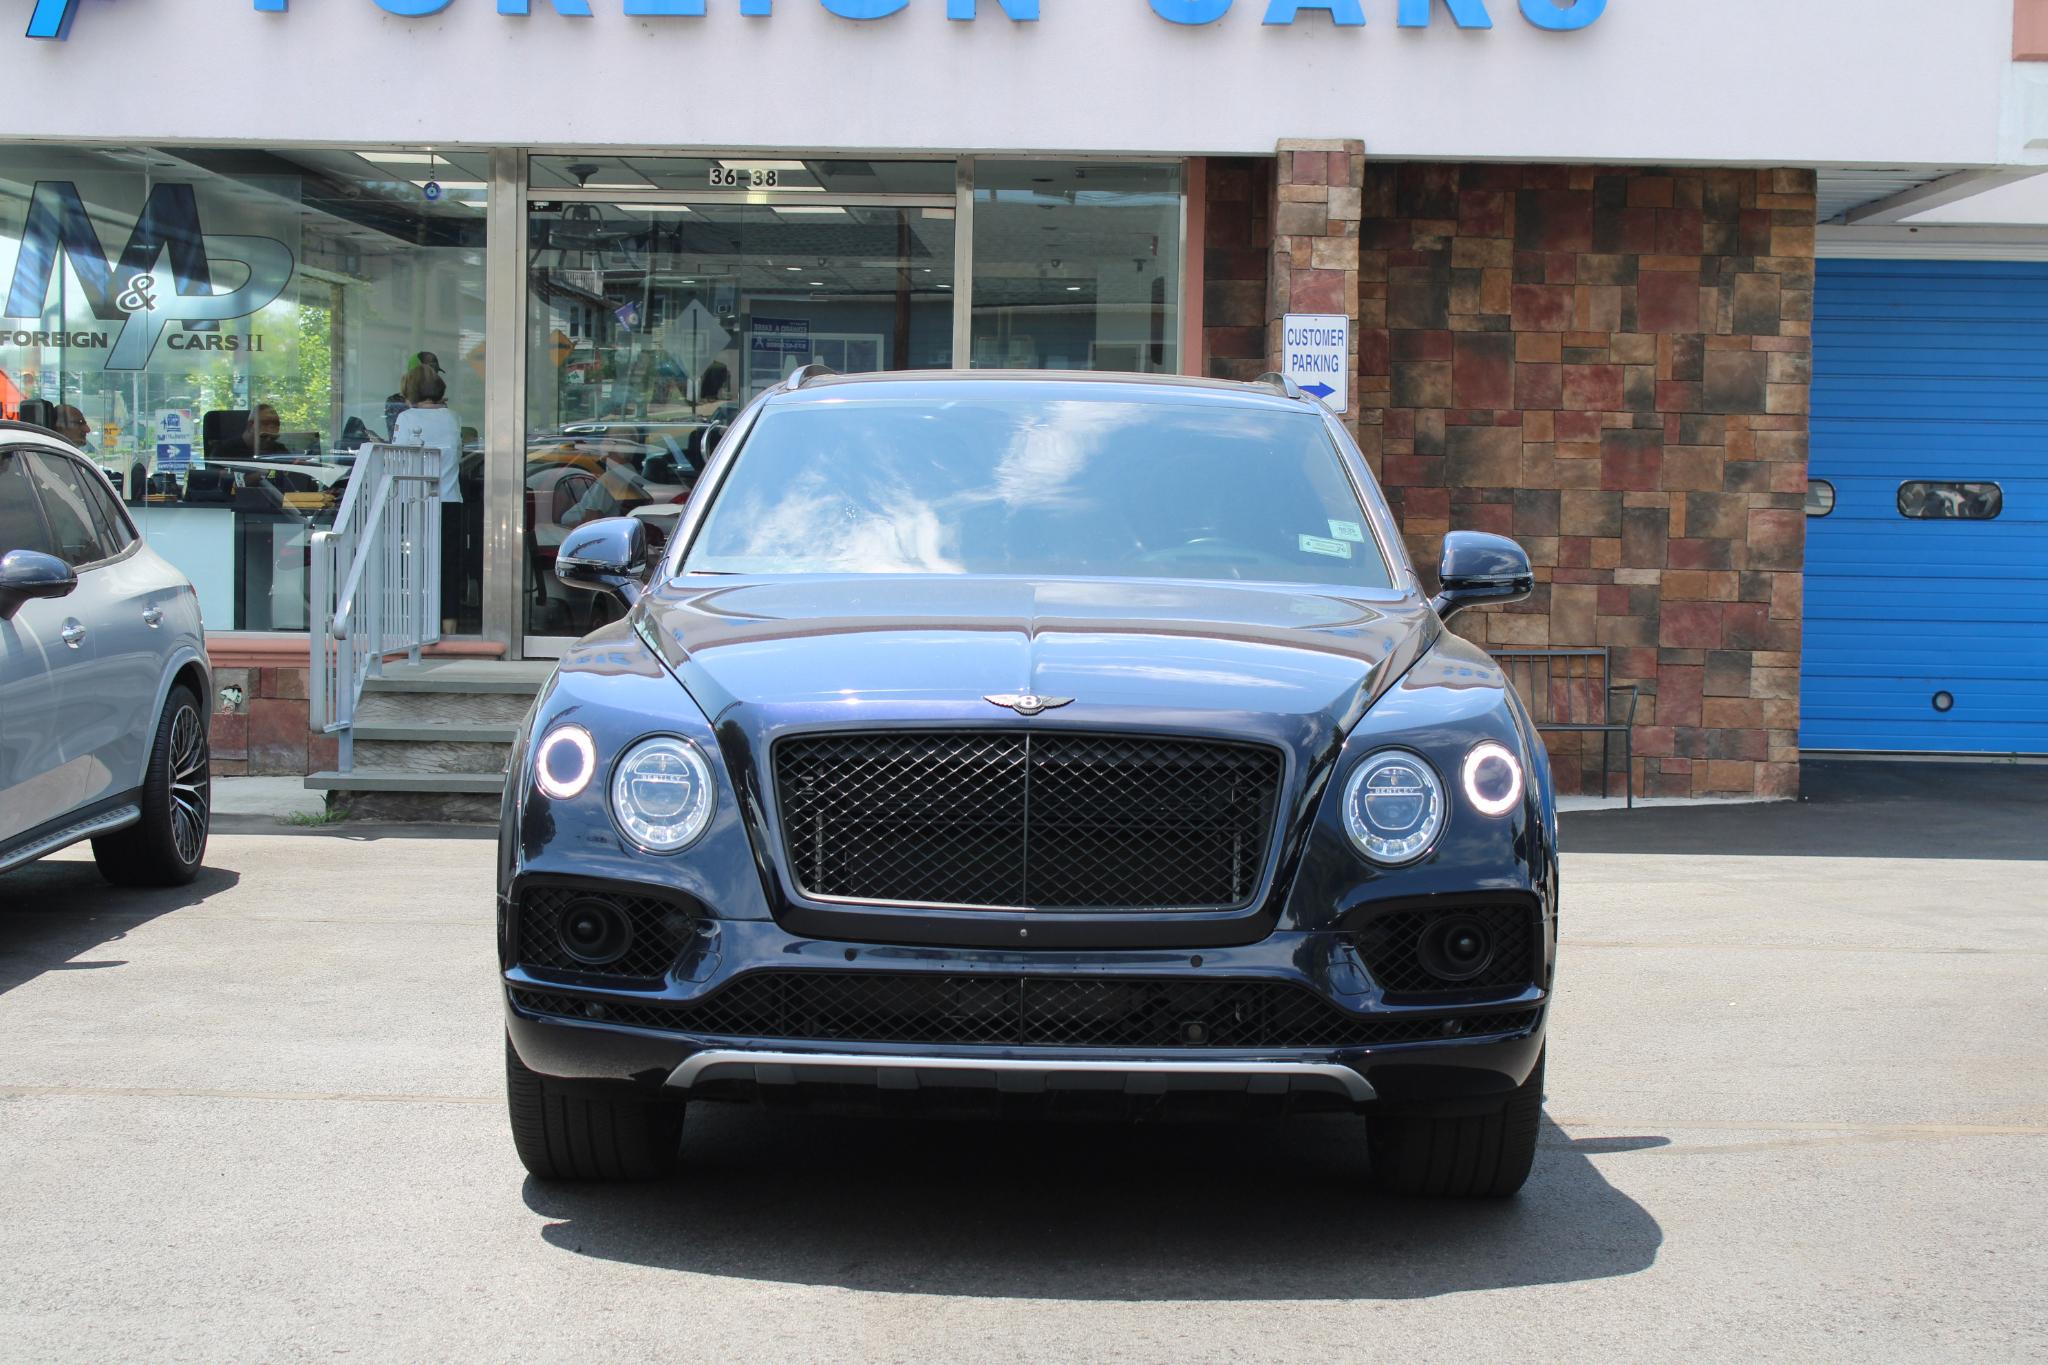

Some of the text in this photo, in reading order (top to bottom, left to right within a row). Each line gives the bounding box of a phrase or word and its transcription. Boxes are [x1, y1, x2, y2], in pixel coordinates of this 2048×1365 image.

[711, 168, 777, 187] 36-38
[0, 331, 264, 352] FOREIGN CARS II
[1287, 328, 1344, 347] CUSTOMER
[1292, 354, 1339, 373] PARKING
